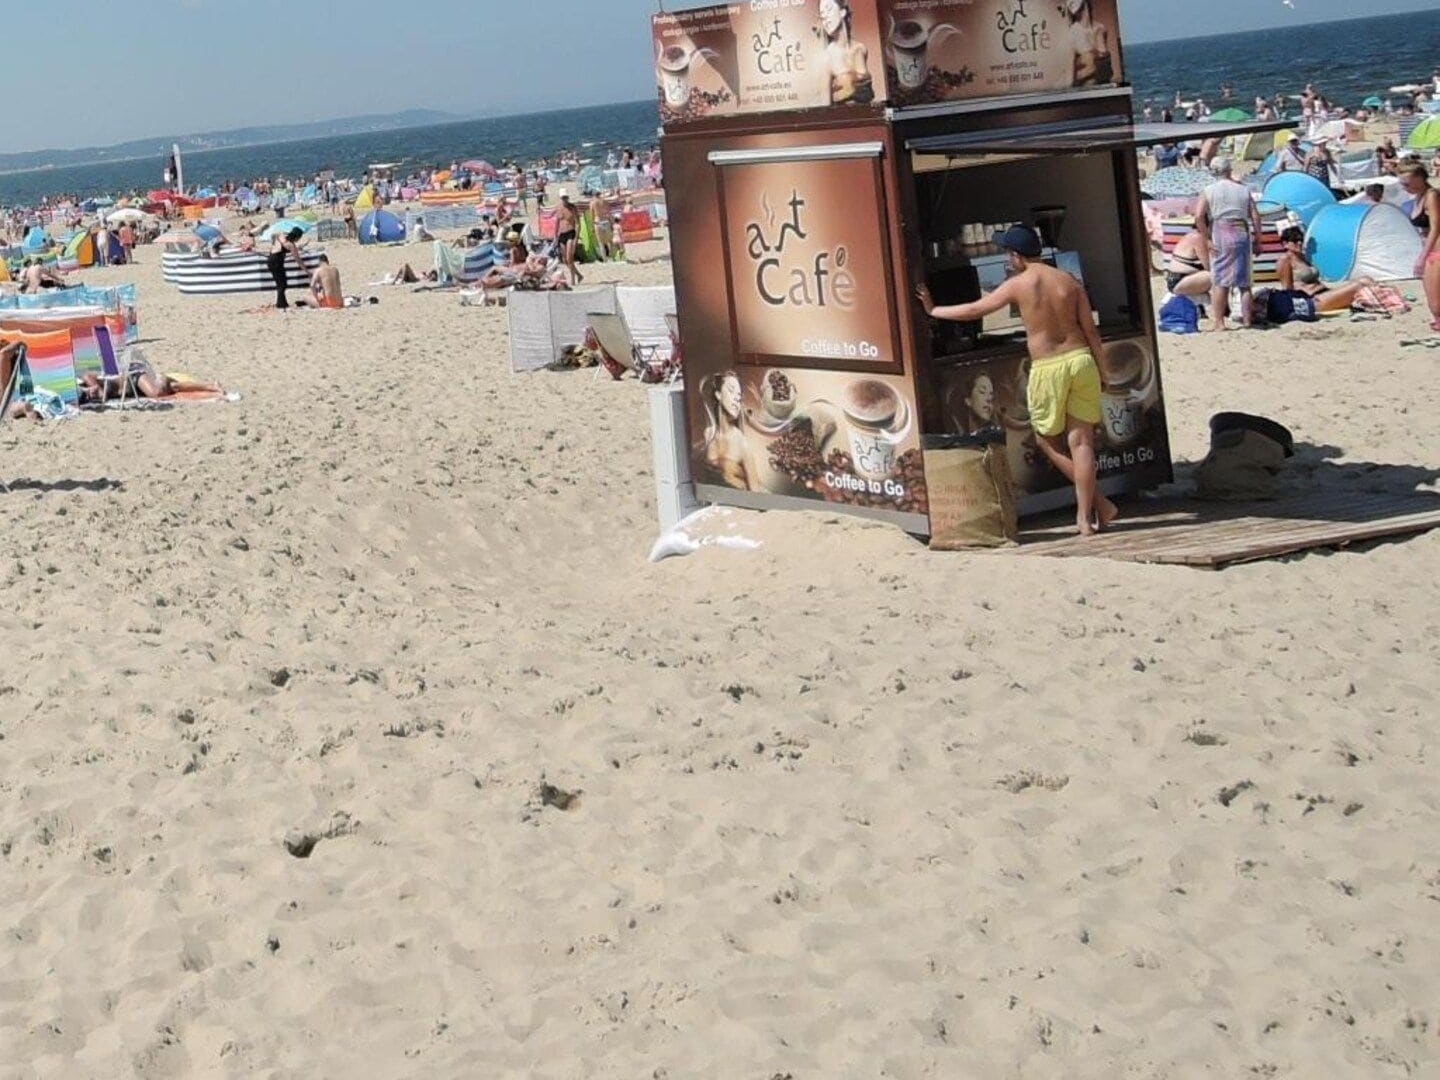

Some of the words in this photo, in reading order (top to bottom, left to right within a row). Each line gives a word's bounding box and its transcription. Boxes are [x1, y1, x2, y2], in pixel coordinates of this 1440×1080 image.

[752, 16, 782, 52] art
[1002, 20, 1051, 53] Café
[758, 41, 806, 74] Café
[746, 189, 807, 259] art
[756, 246, 856, 308] Café
[800, 338, 841, 356] Coffee
[843, 340, 856, 356] to
[859, 340, 878, 358] Go
[1095, 453, 1120, 471] offee
[1123, 450, 1134, 466] to
[1137, 446, 1153, 461] Go
[825, 471, 865, 492] Coffee
[868, 479, 881, 495] to
[884, 479, 904, 497] Go
